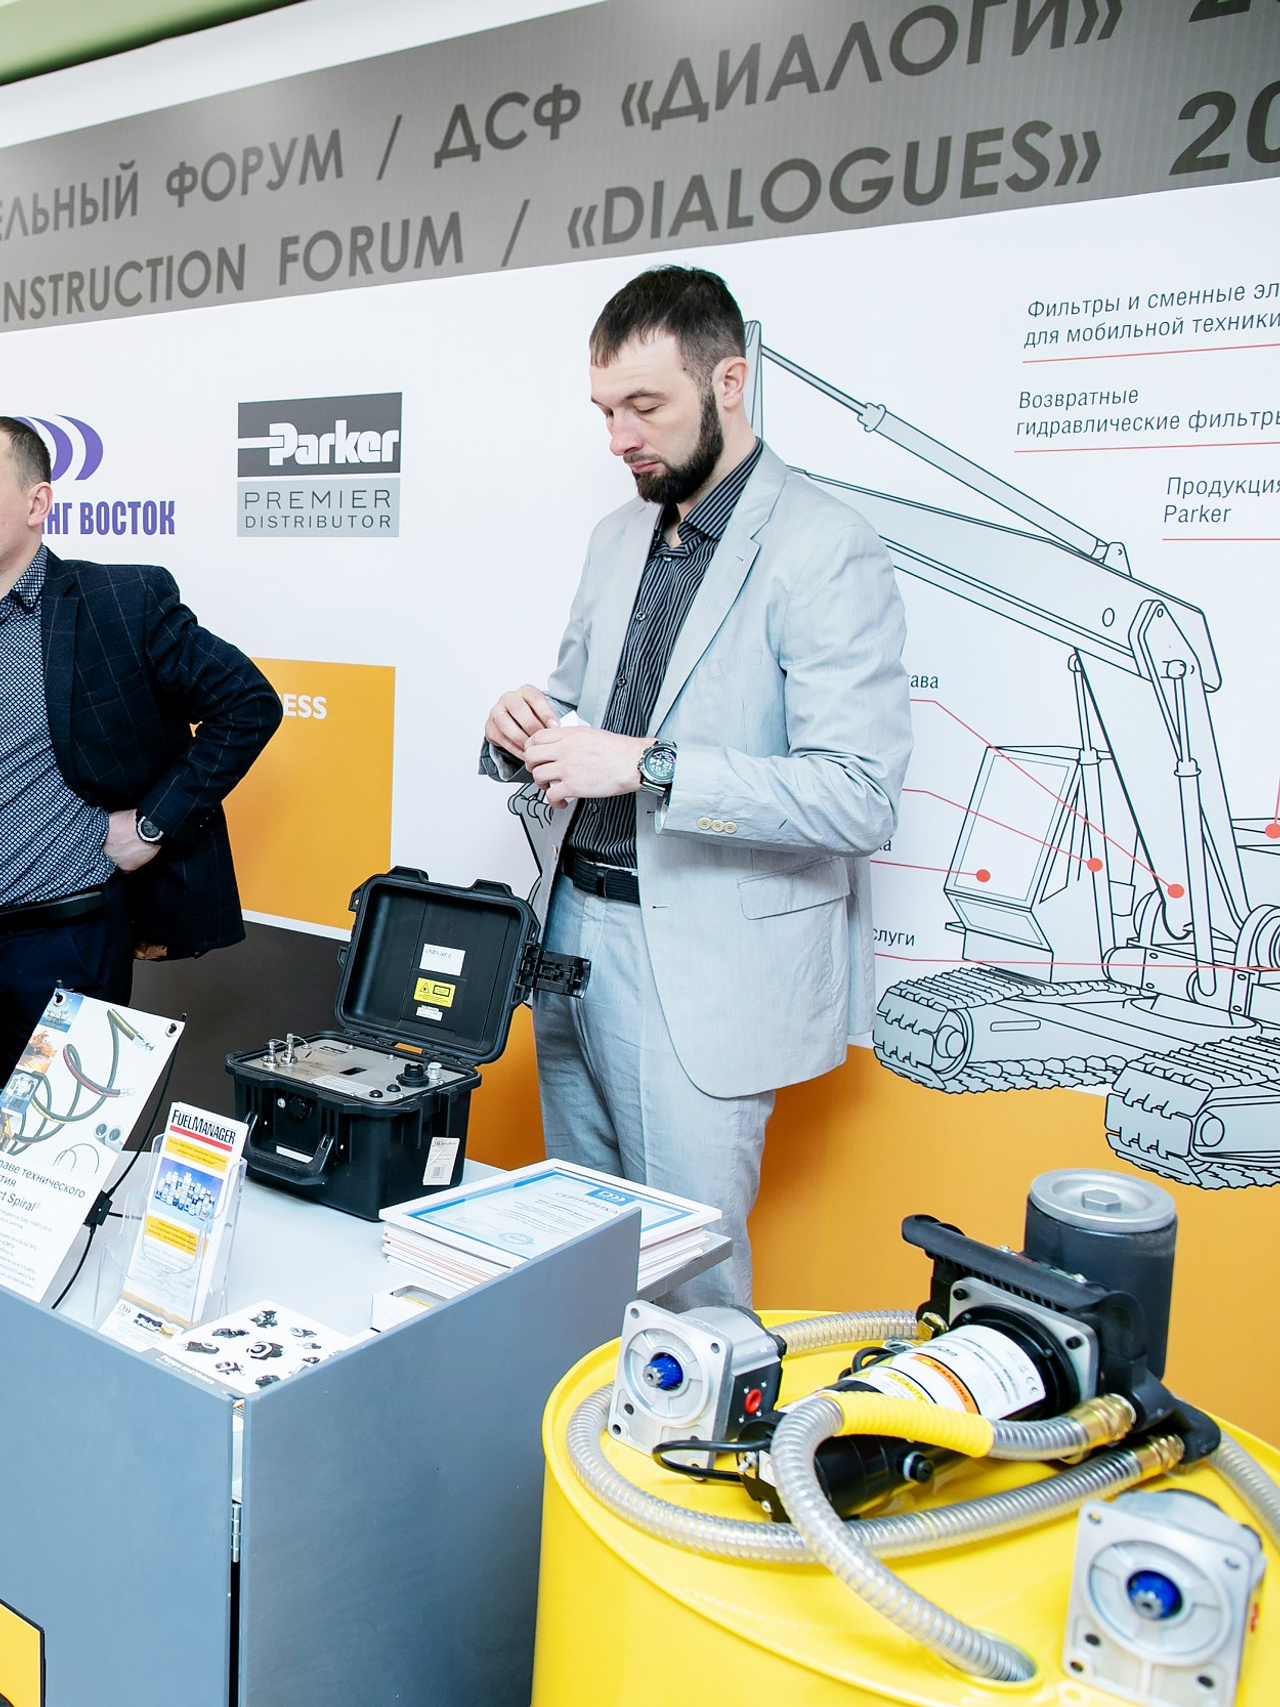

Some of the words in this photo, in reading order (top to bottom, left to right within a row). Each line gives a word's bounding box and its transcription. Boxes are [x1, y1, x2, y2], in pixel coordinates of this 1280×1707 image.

[166, 128, 345, 206] ФОРУМ
[433, 82, 582, 170] ДСФ
[620, 0, 1122, 131] «ДИАЛОГИ»
[277, 212, 465, 288] FORUM
[566, 118, 1103, 250] «DIALOGUES»
[1027, 298, 1121, 318] Фильтры
[1127, 296, 1140, 310] и
[1147, 284, 1246, 310] сменные
[1023, 328, 1059, 349] для
[1066, 317, 1185, 343] мобильной
[1192, 312, 1280, 333] техники
[1019, 388, 1140, 411] Возвратные
[1016, 412, 1180, 438] гидравлические
[269, 419, 400, 466] Parker
[244, 489, 392, 510] PREMIER
[1163, 504, 1232, 523] Parker
[80, 500, 176, 536] ВОСТОК
[245, 514, 392, 529] DISTRIBUTOR
[22, 1167, 86, 1199] технического
